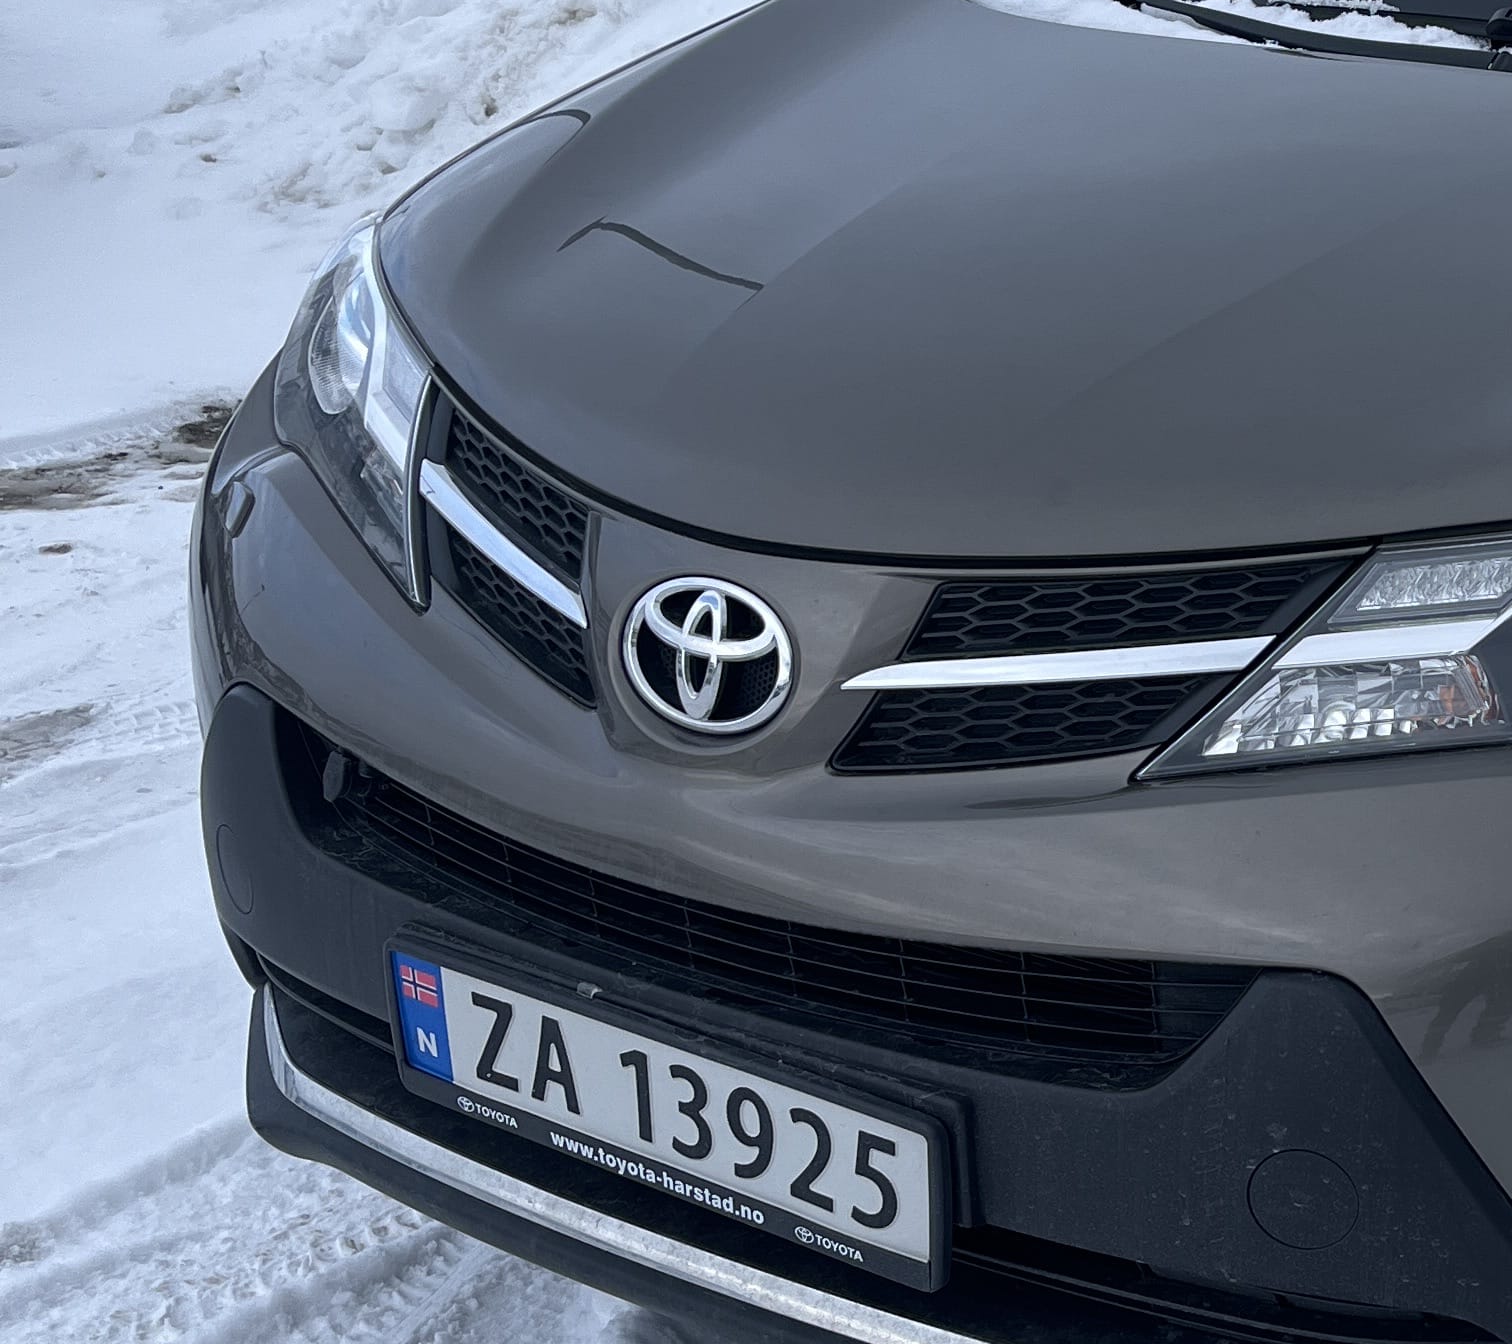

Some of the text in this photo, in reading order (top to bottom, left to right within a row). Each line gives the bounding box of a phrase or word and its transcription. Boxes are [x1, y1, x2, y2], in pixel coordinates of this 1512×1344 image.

[417, 991, 898, 1230] N ZA 13925
[475, 1102, 864, 1263] TOYOTA www.toyota-harstad.no TOYOTA
